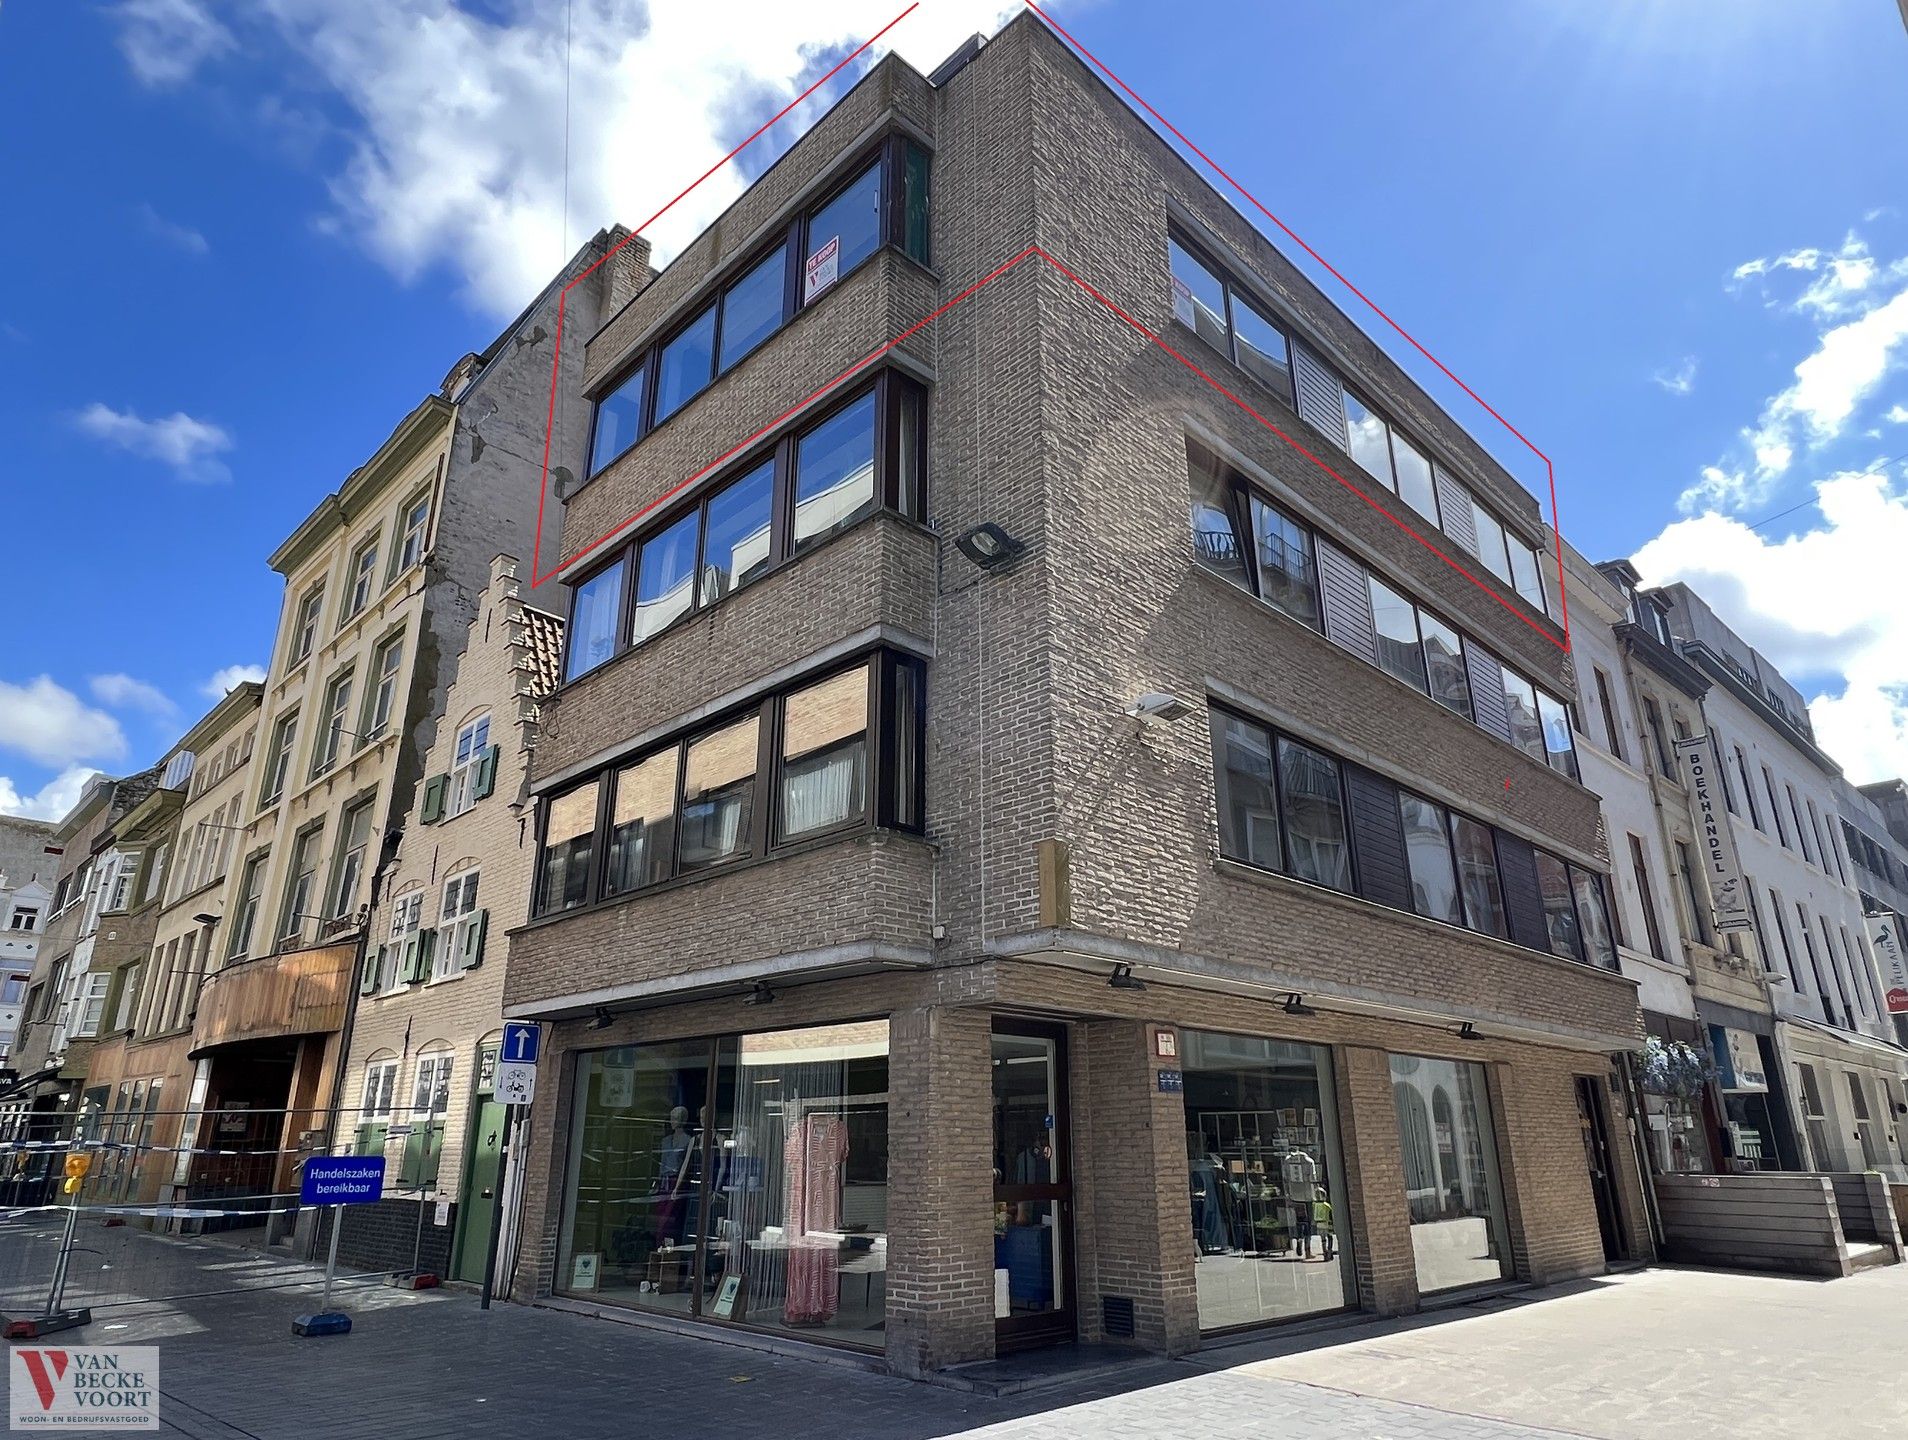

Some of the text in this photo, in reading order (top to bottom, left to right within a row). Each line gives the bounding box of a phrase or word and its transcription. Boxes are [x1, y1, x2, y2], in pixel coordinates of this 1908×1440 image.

[1689, 754, 1725, 872] BOEKHANDEL
[310, 1168, 381, 1180] Handelszaken
[316, 1182, 371, 1194] bereikbaar
